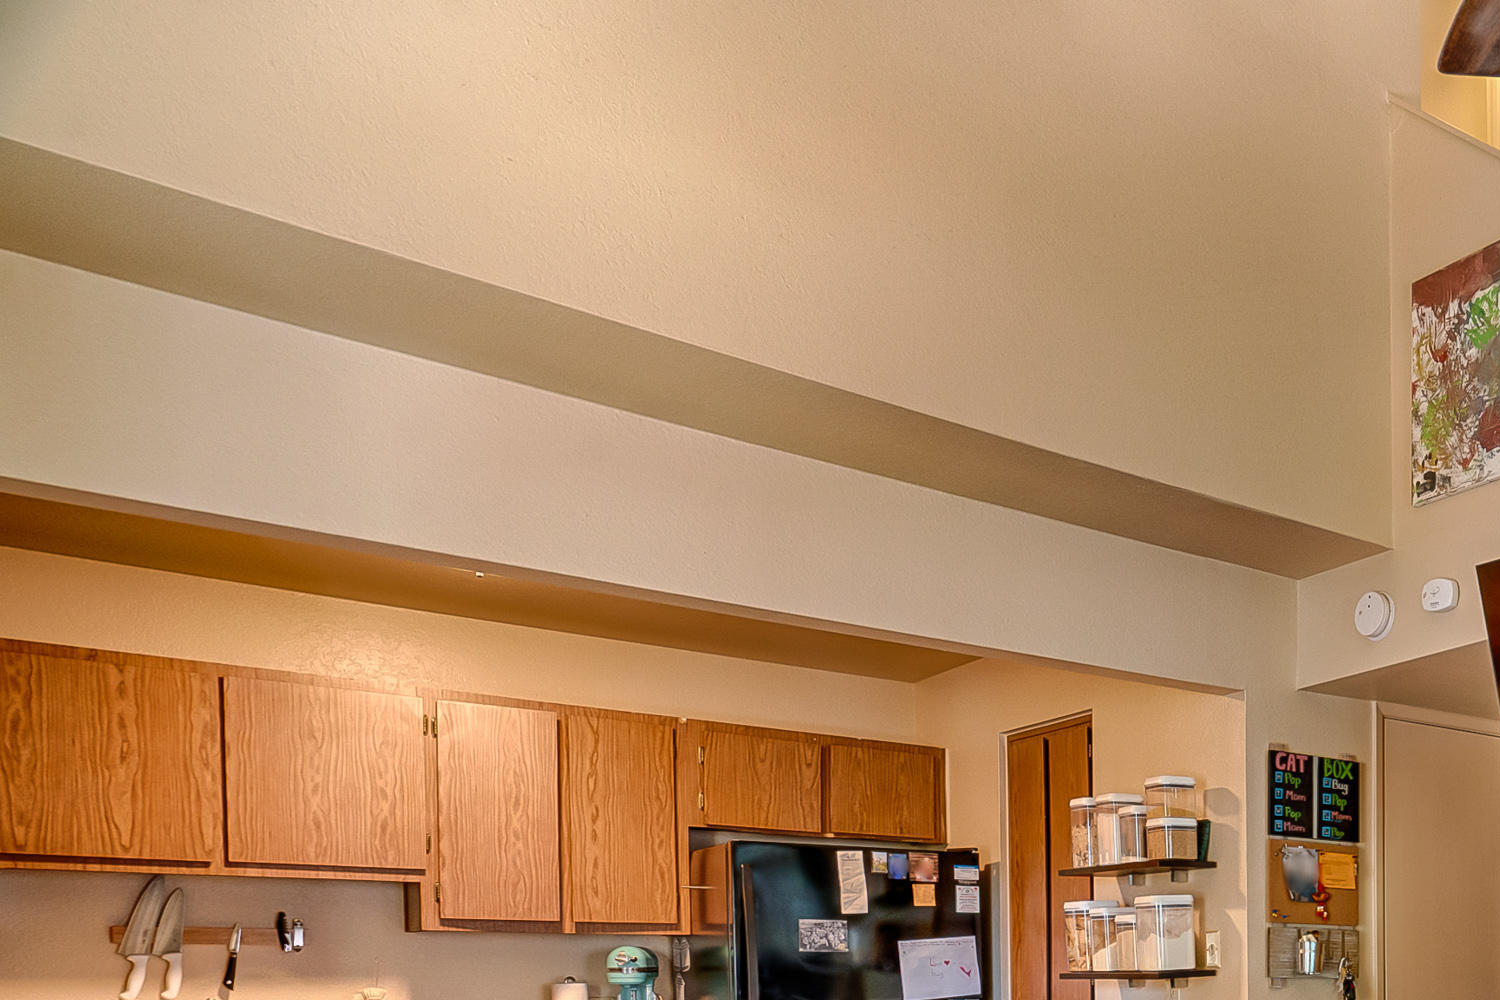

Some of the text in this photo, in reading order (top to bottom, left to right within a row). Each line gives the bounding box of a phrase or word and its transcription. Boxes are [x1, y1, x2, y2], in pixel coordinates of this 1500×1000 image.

[1275, 752, 1308, 773] CAT
[1324, 758, 1354, 780] BOX
[1284, 772, 1301, 788] Pop
[1331, 778, 1349, 795] Bug
[1285, 789, 1307, 802] Mom
[1331, 793, 1347, 811] Pop
[1285, 806, 1302, 822] Pop
[1283, 821, 1306, 833] Mom
